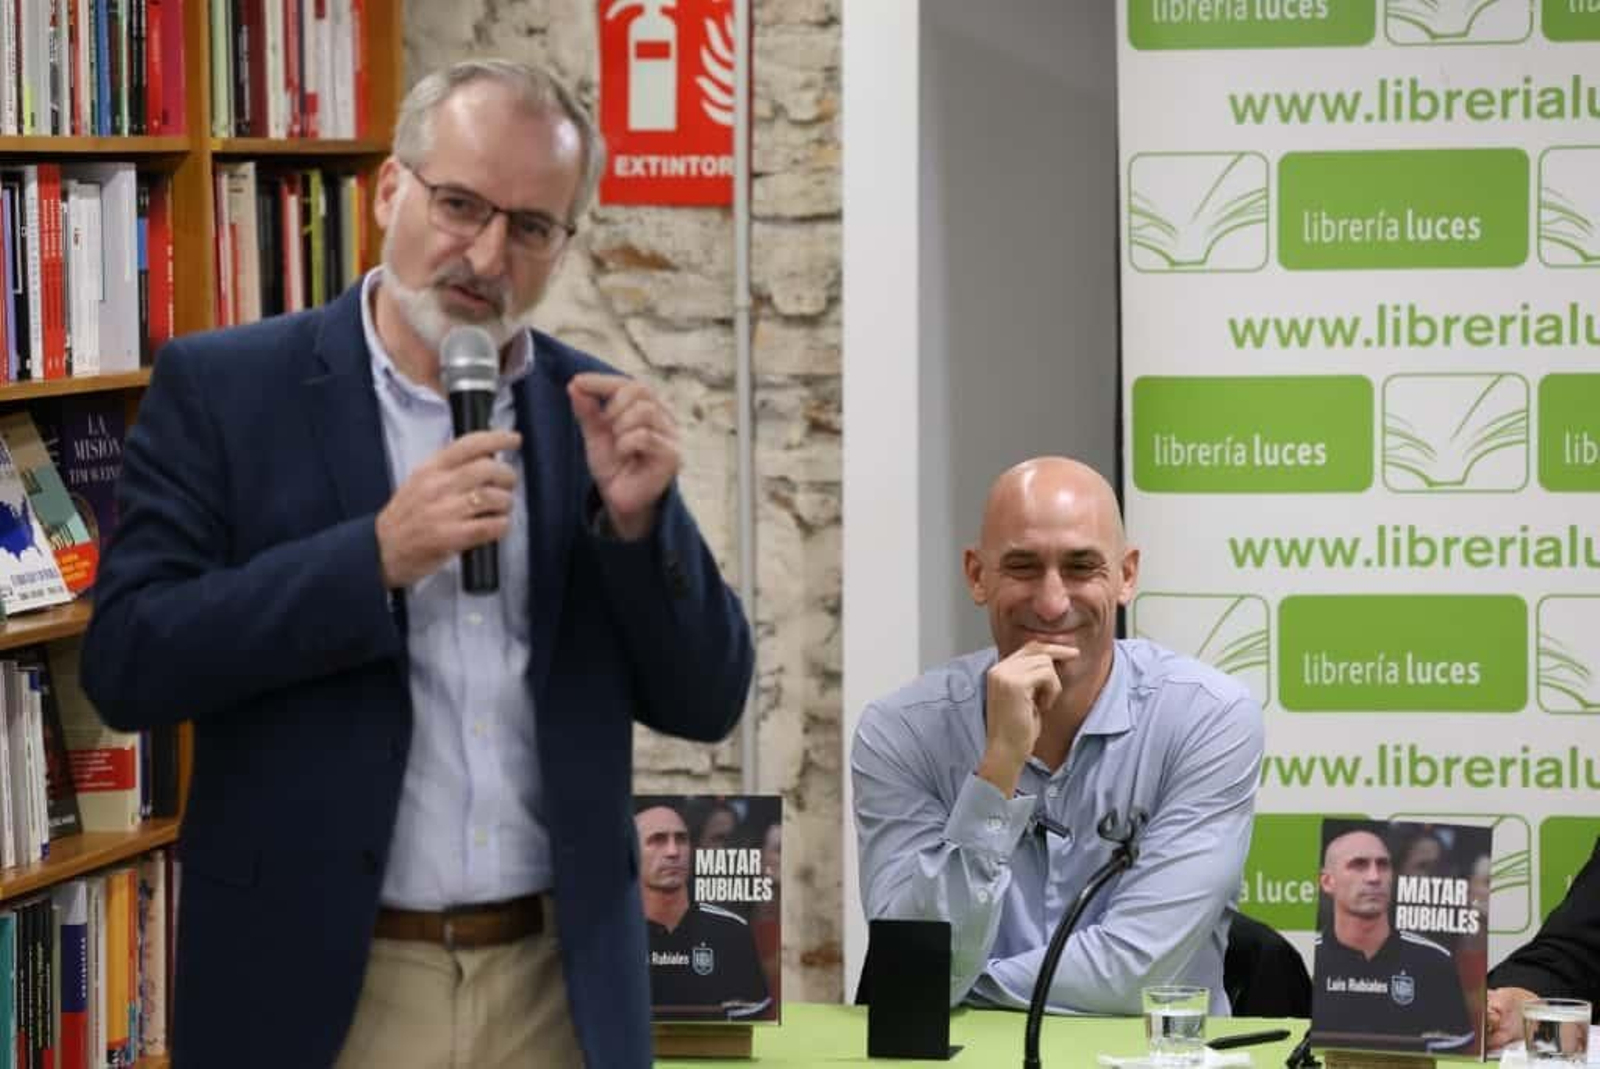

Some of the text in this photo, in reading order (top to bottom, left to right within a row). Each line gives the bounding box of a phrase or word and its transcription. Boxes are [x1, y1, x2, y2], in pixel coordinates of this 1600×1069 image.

[1255, 0, 1328, 20] luces
[1304, 209, 1481, 242] librería luces
[1155, 434, 1327, 467] librería luces
[1304, 652, 1480, 685] librería luces
[1261, 744, 1600, 789] ww.librerialu
[695, 848, 762, 876] MATAR
[694, 876, 773, 902] RUBIALES
[1256, 871, 1319, 903] luce
[1398, 875, 1468, 906] MATAR
[1396, 905, 1480, 934] RUBIALES
[651, 950, 689, 966] Rubiales
[1348, 977, 1388, 994] Rubiales
